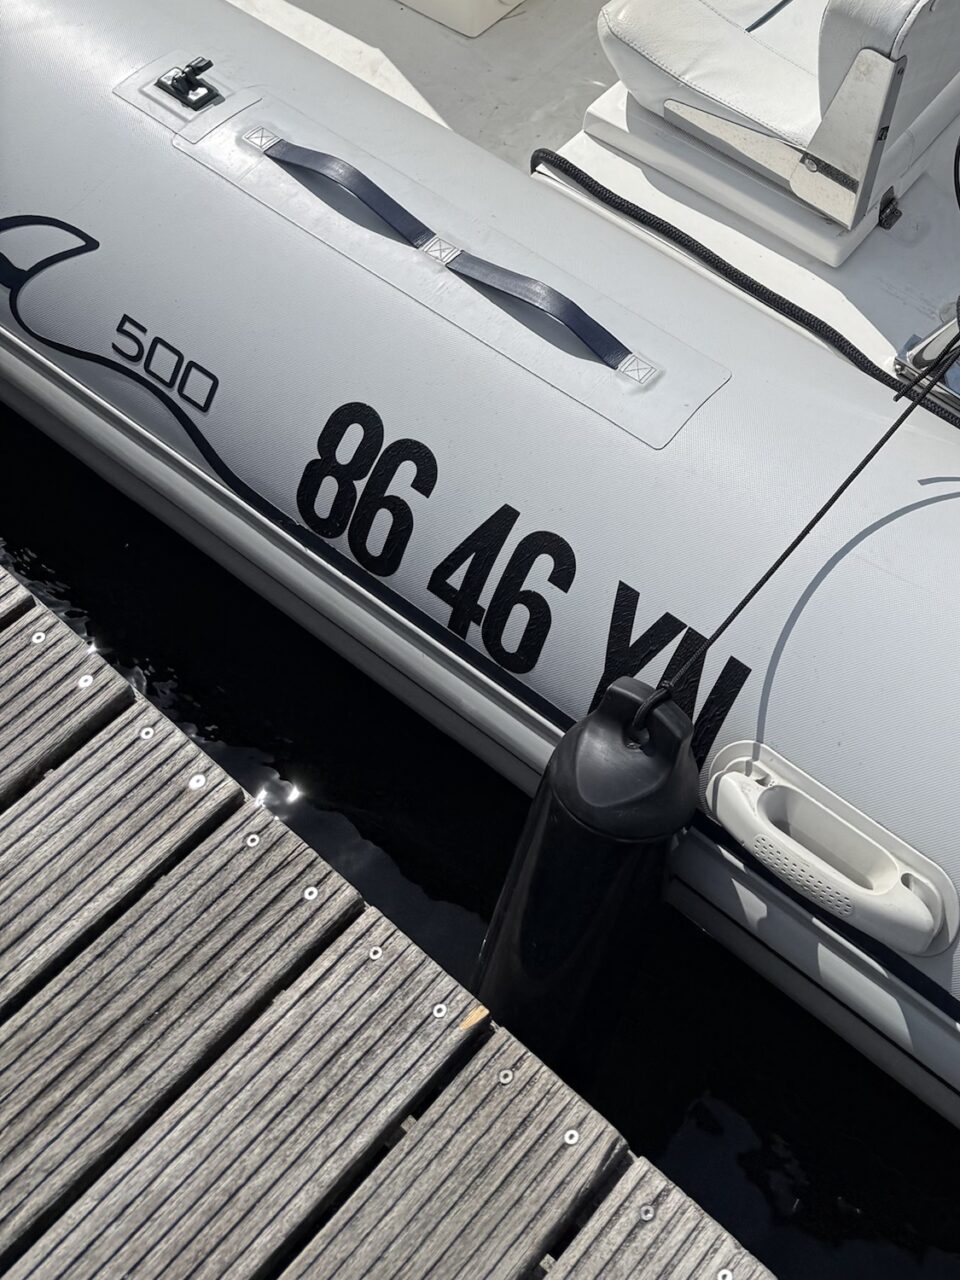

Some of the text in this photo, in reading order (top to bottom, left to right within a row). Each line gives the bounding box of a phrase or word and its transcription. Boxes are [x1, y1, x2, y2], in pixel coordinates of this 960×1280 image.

[111, 314, 219, 414] 500
[296, 402, 438, 577] 86
[426, 503, 577, 675] 46
